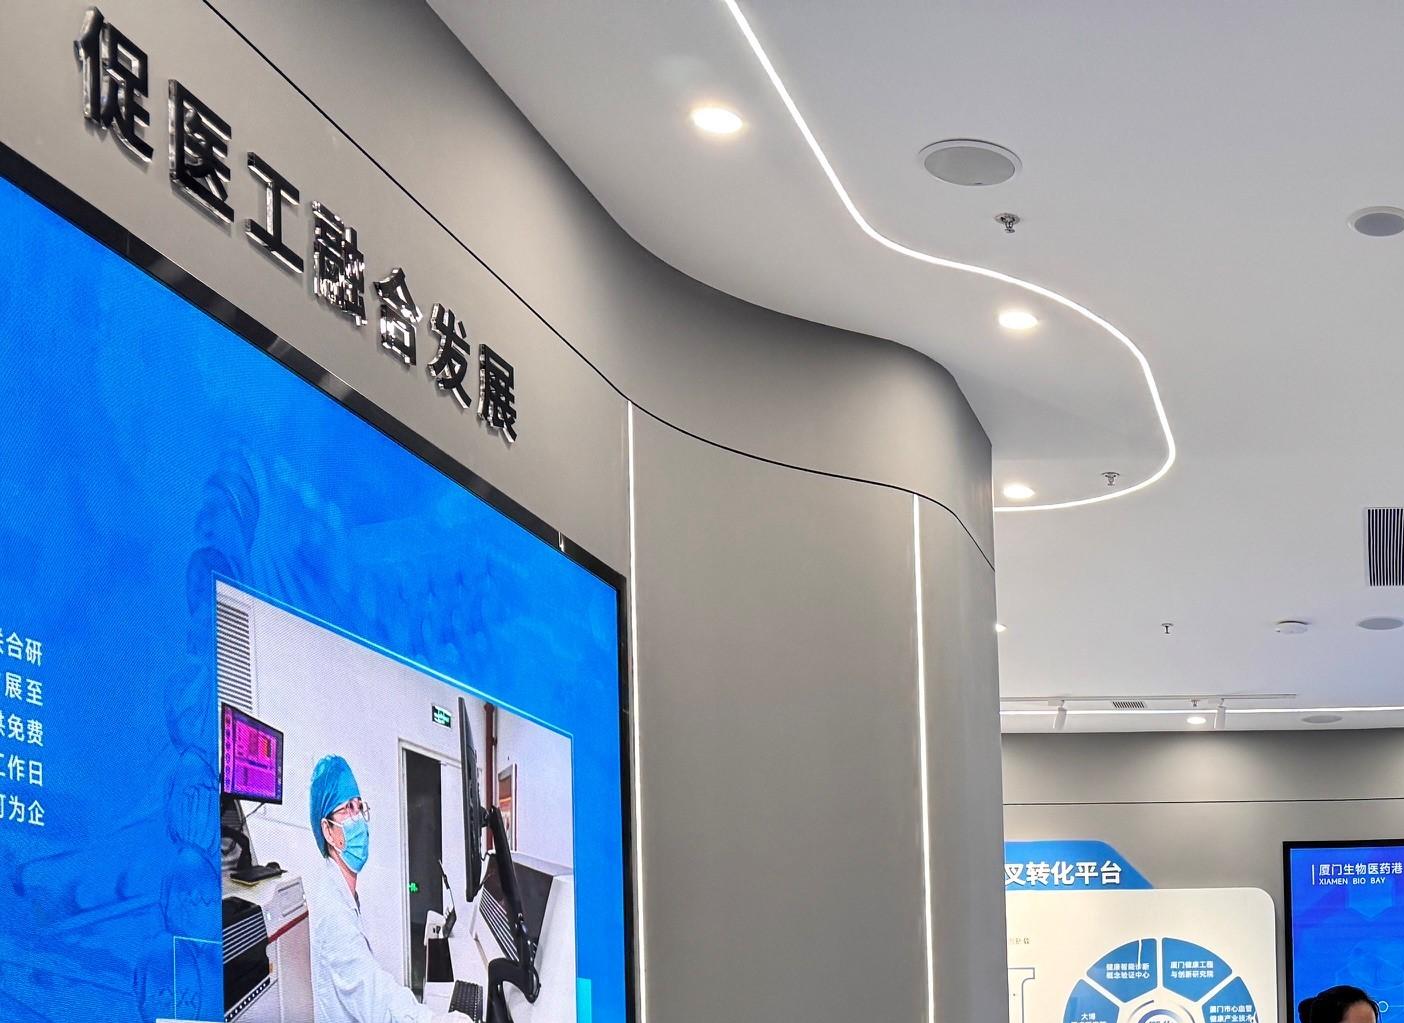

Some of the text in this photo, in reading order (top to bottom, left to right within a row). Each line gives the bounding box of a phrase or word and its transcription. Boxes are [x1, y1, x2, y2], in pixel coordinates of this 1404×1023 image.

[74, 6, 517, 443] 促医工融合发展
[0, 628, 43, 667] 合研
[1319, 862, 1403, 876] 厦门生物医药港
[1170, 970, 1214, 978] 与创新研究院
